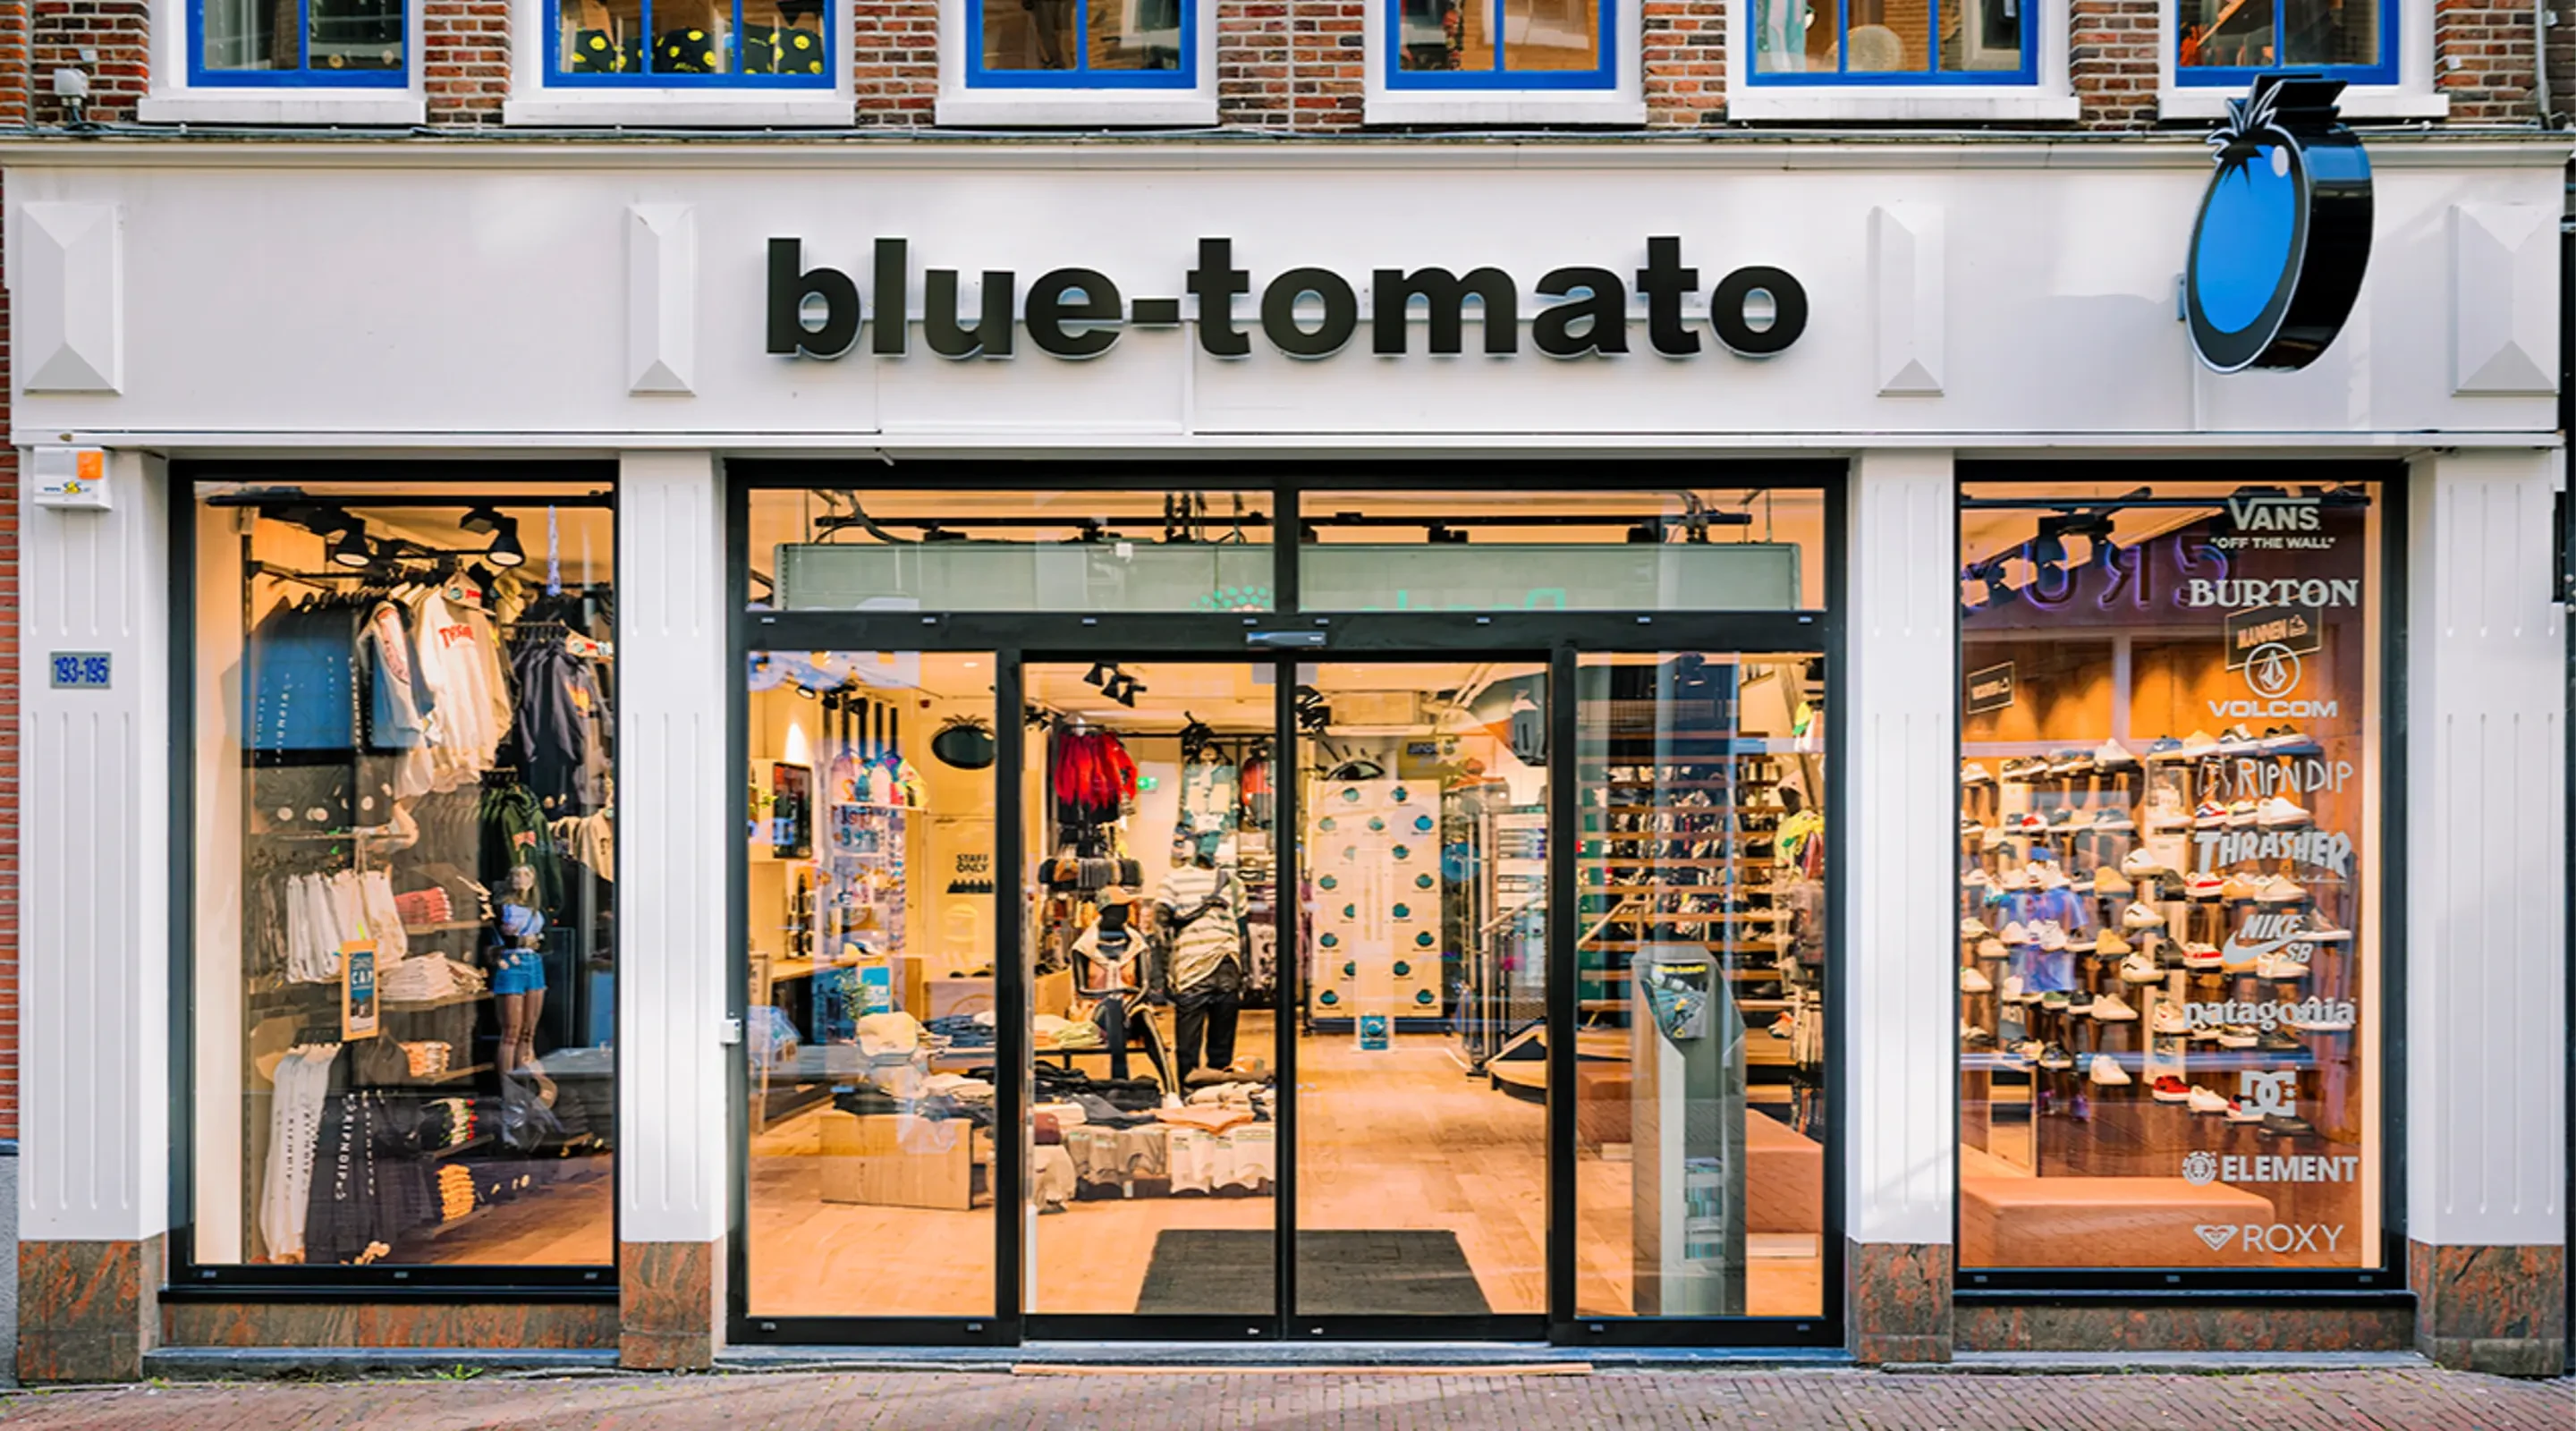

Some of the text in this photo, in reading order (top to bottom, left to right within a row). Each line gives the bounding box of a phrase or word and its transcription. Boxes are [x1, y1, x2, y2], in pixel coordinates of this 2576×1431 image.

[767, 236, 1809, 360] blue-tomato
[2228, 497, 2322, 531] VANS
[2210, 538, 2336, 549] "OFF THE WALL"
[2189, 578, 2359, 607] BURTON
[55, 656, 107, 684] 193-195
[2207, 700, 2338, 717] VOLCOM
[955, 862, 989, 874] ONLY
[2193, 831, 2351, 878] THRASHER
[2239, 914, 2303, 939] NIKE
[2284, 943, 2314, 963] SB
[2182, 998, 2357, 1031] patagonia
[2222, 1156, 2359, 1182] ELEMENT
[2243, 1224, 2344, 1252] ROXY
